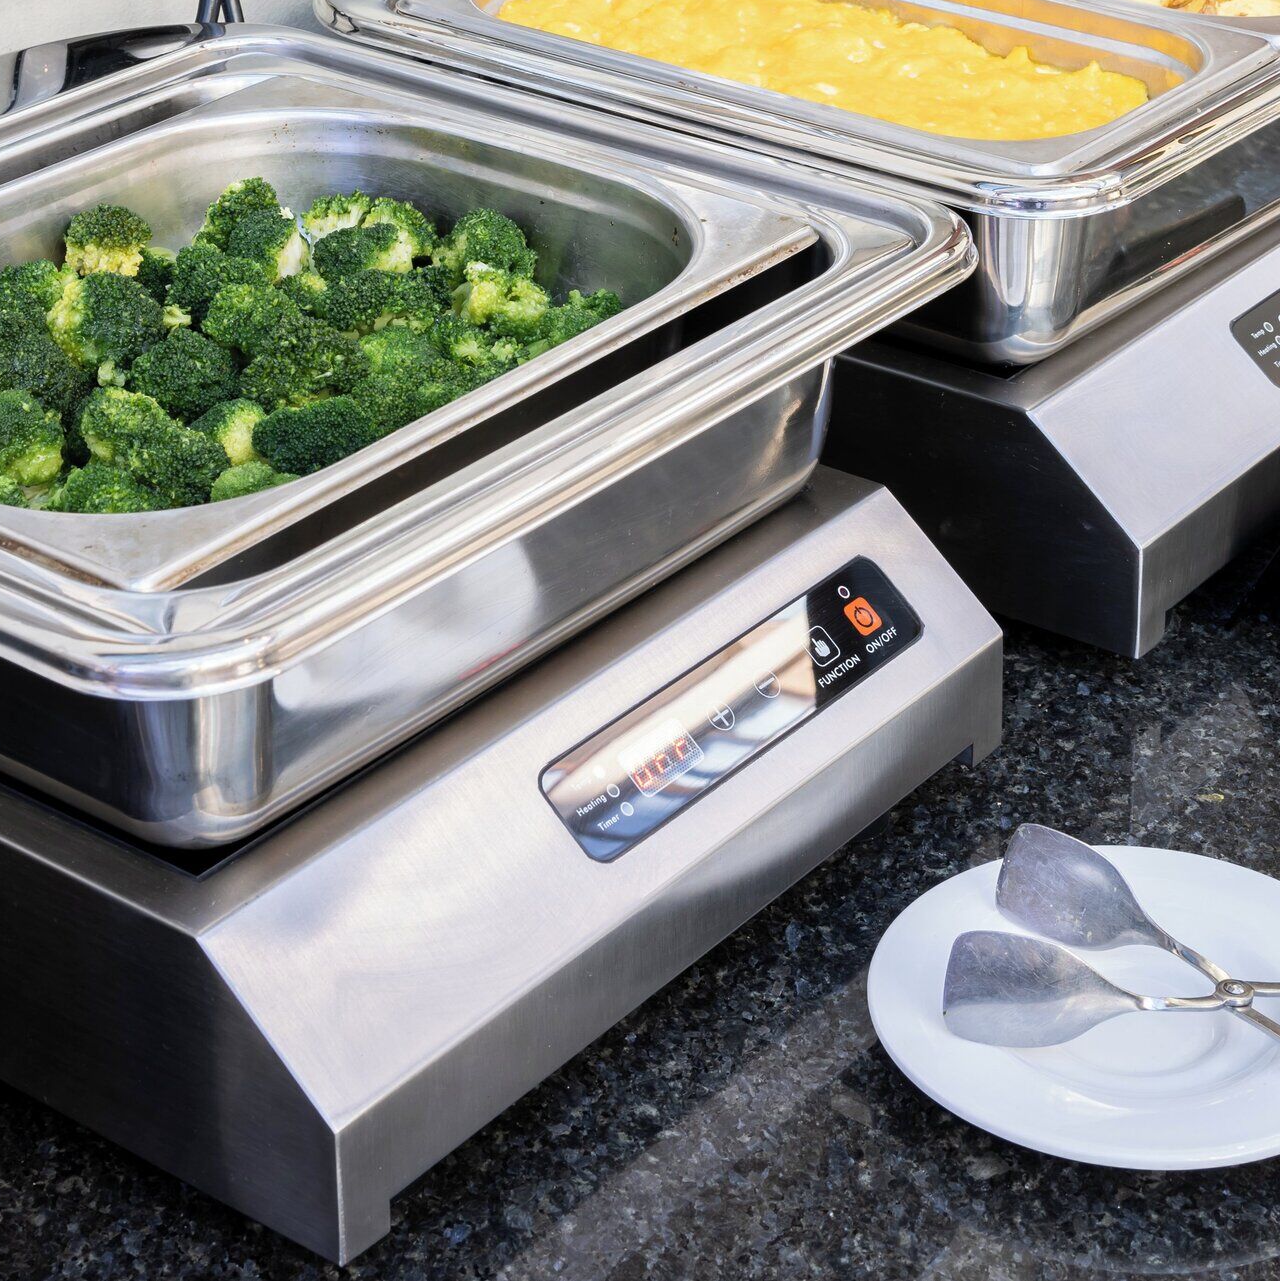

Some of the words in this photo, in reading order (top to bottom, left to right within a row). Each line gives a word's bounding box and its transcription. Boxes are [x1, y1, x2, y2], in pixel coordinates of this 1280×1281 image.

[1250, 328, 1266, 339] Temp
[1257, 342, 1278, 357] Heating
[865, 626, 898, 654] ON/OFF
[817, 654, 861, 689] FUNCTION
[575, 793, 608, 817] Heating
[596, 813, 620, 832] Timer
